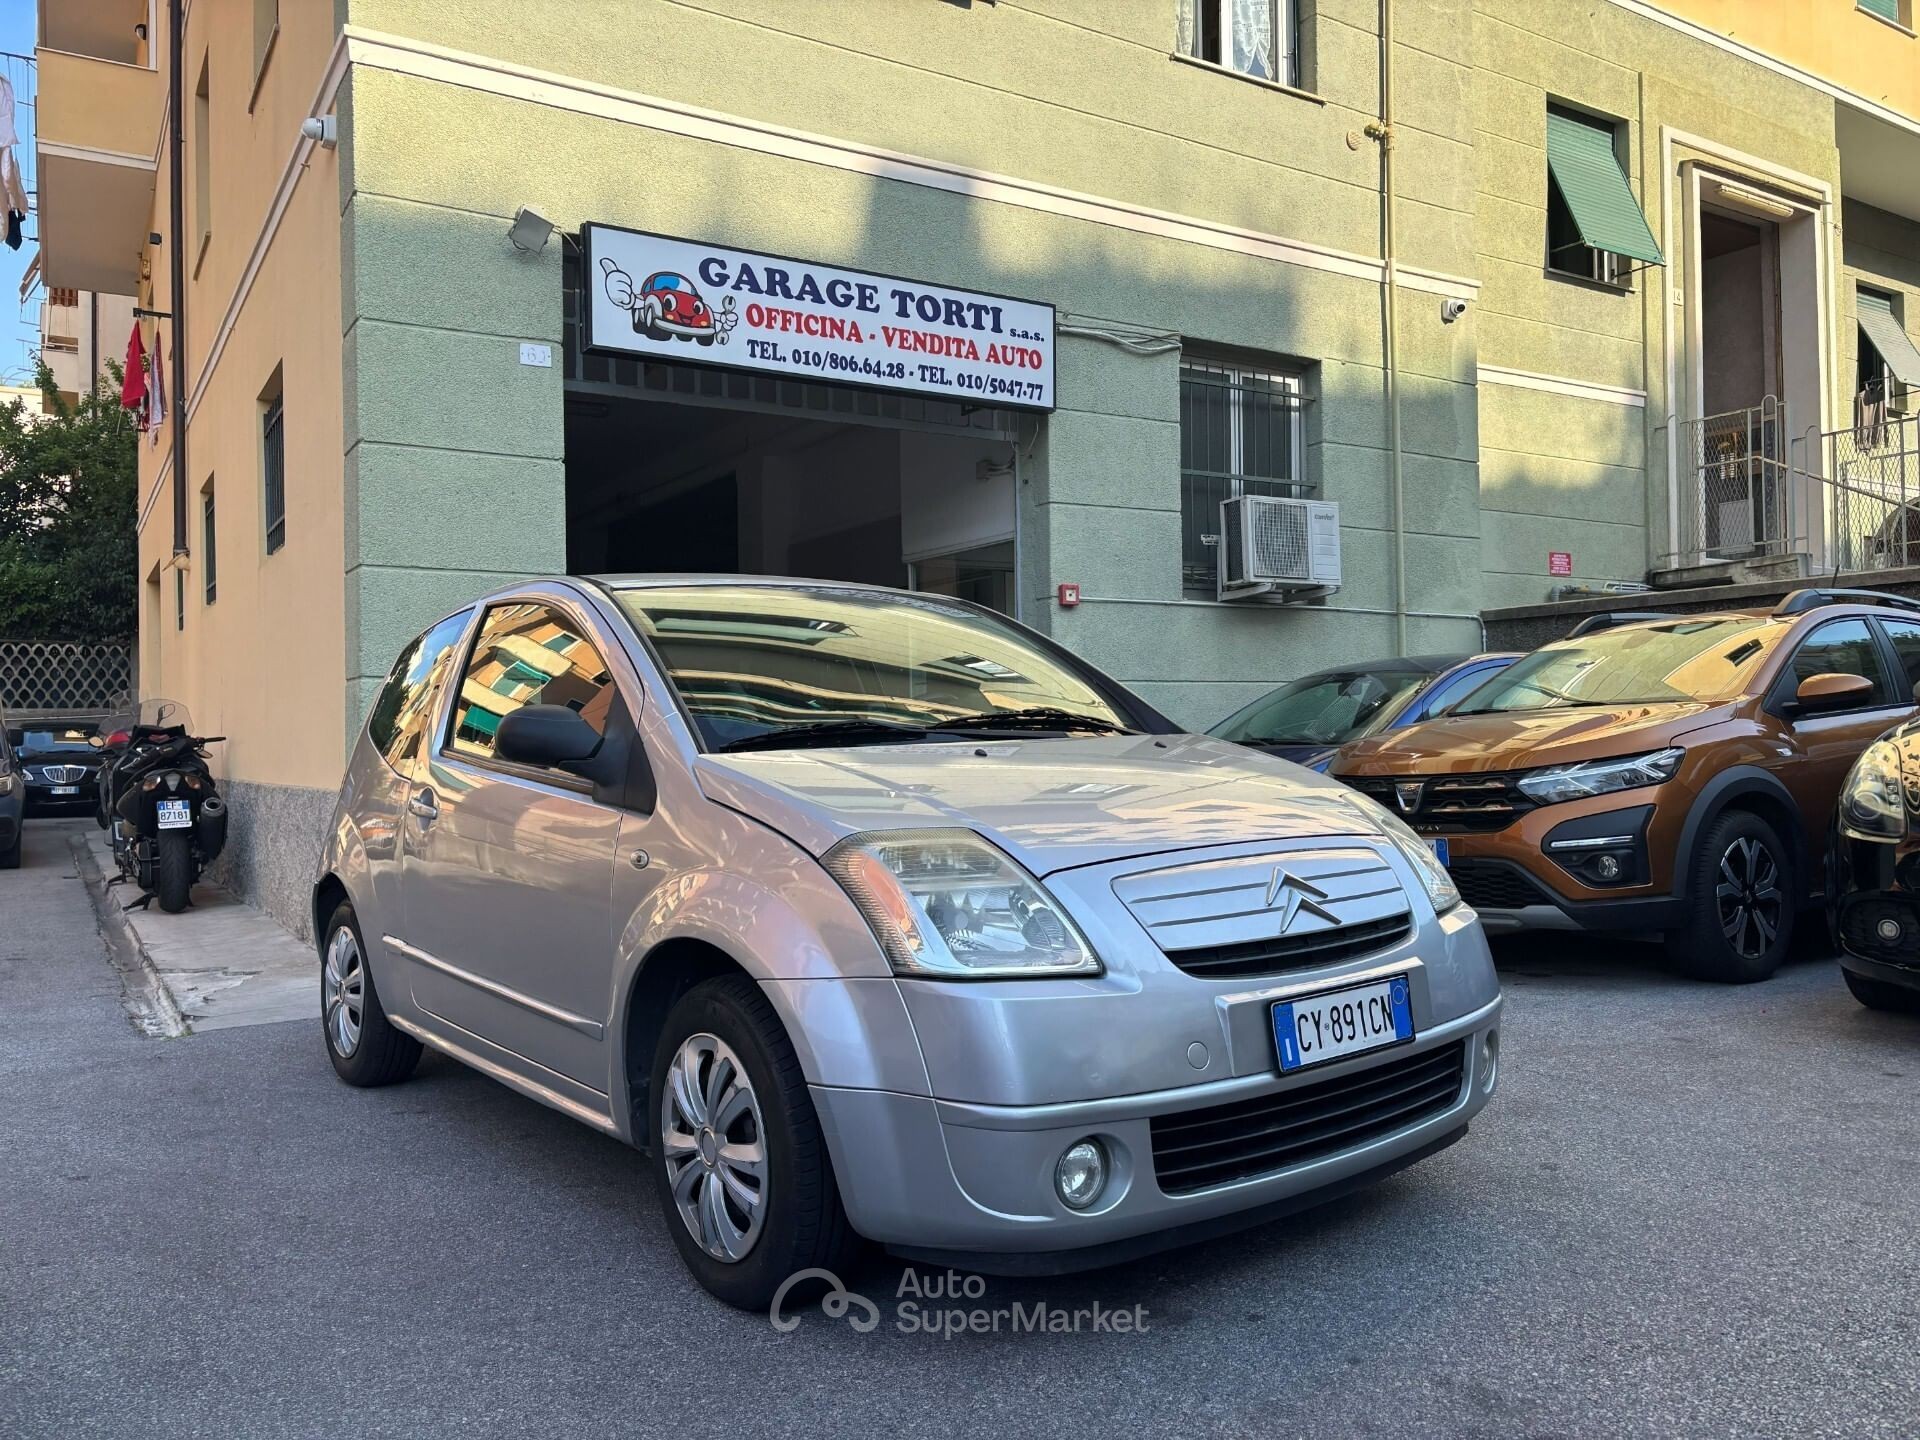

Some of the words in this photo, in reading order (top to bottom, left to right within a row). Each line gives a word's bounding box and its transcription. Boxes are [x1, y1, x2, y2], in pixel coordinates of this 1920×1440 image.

[698, 257, 880, 313] GARAGE
[890, 289, 1003, 333] TORTI
[1010, 328, 1045, 342] s.a.s.
[745, 303, 863, 343] OFFICINA
[881, 326, 980, 361] VENDITA
[985, 343, 1043, 370] AUTO
[747, 339, 787, 362] TEL.
[792, 349, 905, 379] 010/806.64.28
[918, 364, 953, 386] TEL.
[160, 811, 188, 821] 87181
